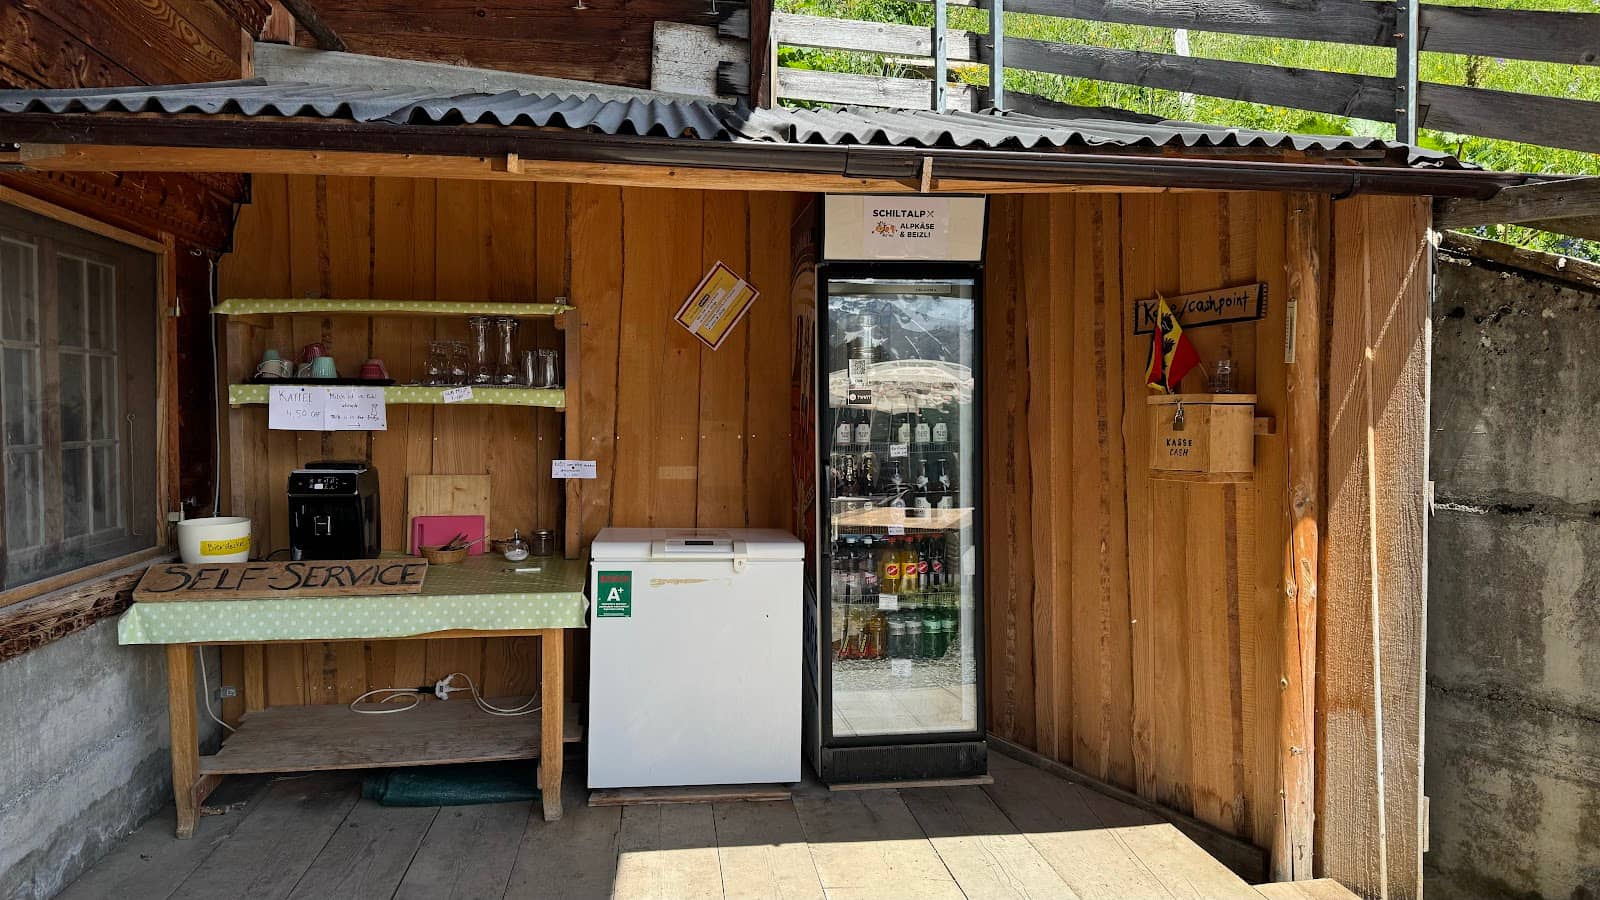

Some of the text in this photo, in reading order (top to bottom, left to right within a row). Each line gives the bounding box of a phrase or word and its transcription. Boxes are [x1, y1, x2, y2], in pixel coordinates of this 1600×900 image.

[872, 209, 926, 218] SCHILTALP
[900, 222, 935, 230] ALPKÄSE
[278, 390, 313, 404] KAFFEE
[1166, 438, 1193, 447] KASSE
[1169, 448, 1189, 457] CASH
[144, 562, 426, 593] SELF-SERVICE
